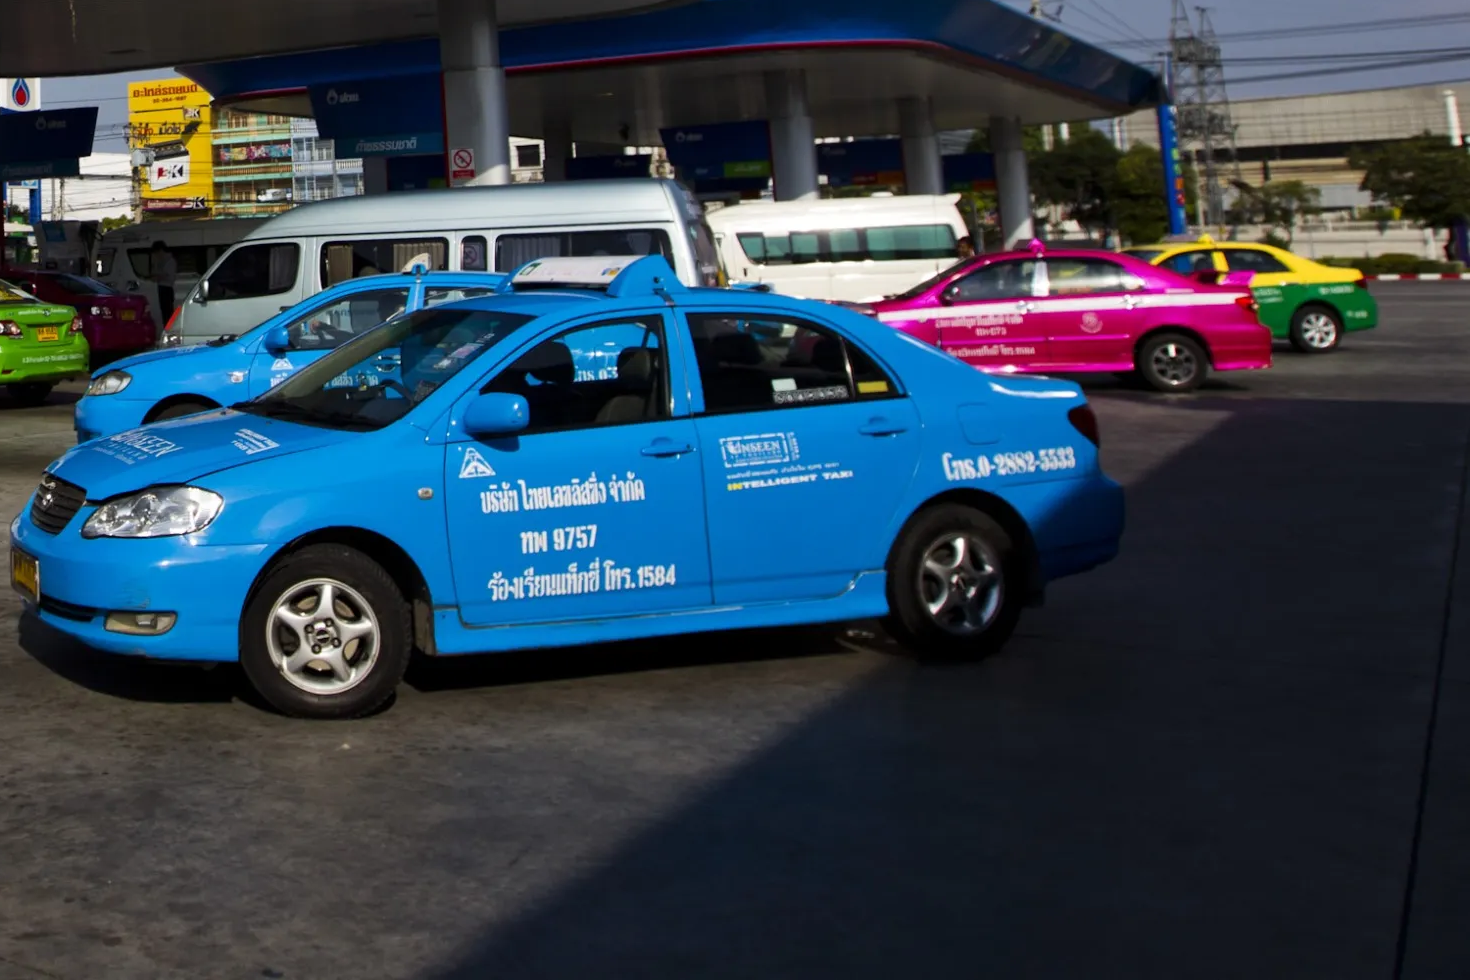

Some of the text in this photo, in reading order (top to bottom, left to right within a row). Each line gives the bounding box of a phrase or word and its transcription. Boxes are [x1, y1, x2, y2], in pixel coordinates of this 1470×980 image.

[479, 481, 520, 514] บริษัท
[608, 471, 646, 503] จำกัด
[727, 474, 818, 491] INTELLIGENT
[822, 470, 854, 480] TAXI
[552, 524, 598, 552] 9757
[603, 560, 676, 591] โทร.1584
